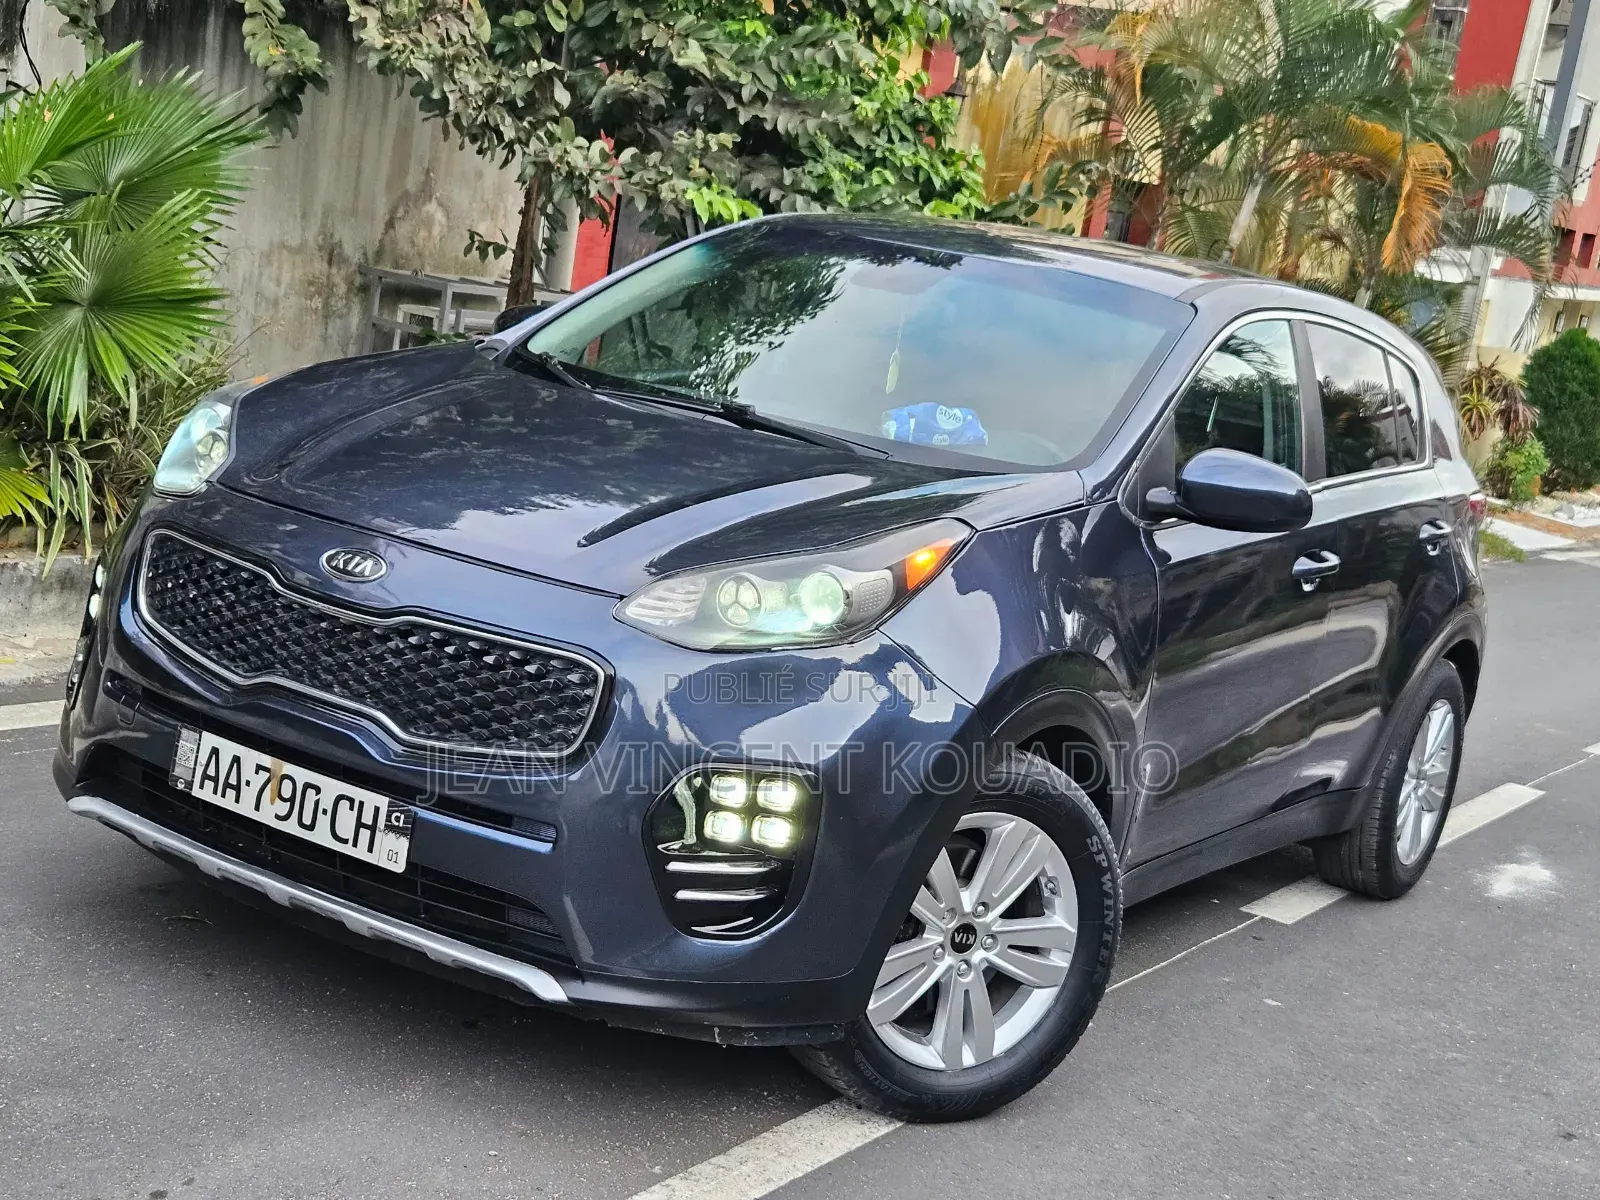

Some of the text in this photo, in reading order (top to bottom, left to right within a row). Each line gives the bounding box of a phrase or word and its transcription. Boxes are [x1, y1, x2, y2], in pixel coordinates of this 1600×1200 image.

[938, 407, 962, 424] style
[329, 552, 374, 576] KIA
[391, 812, 405, 827] CI
[387, 849, 399, 864] 01
